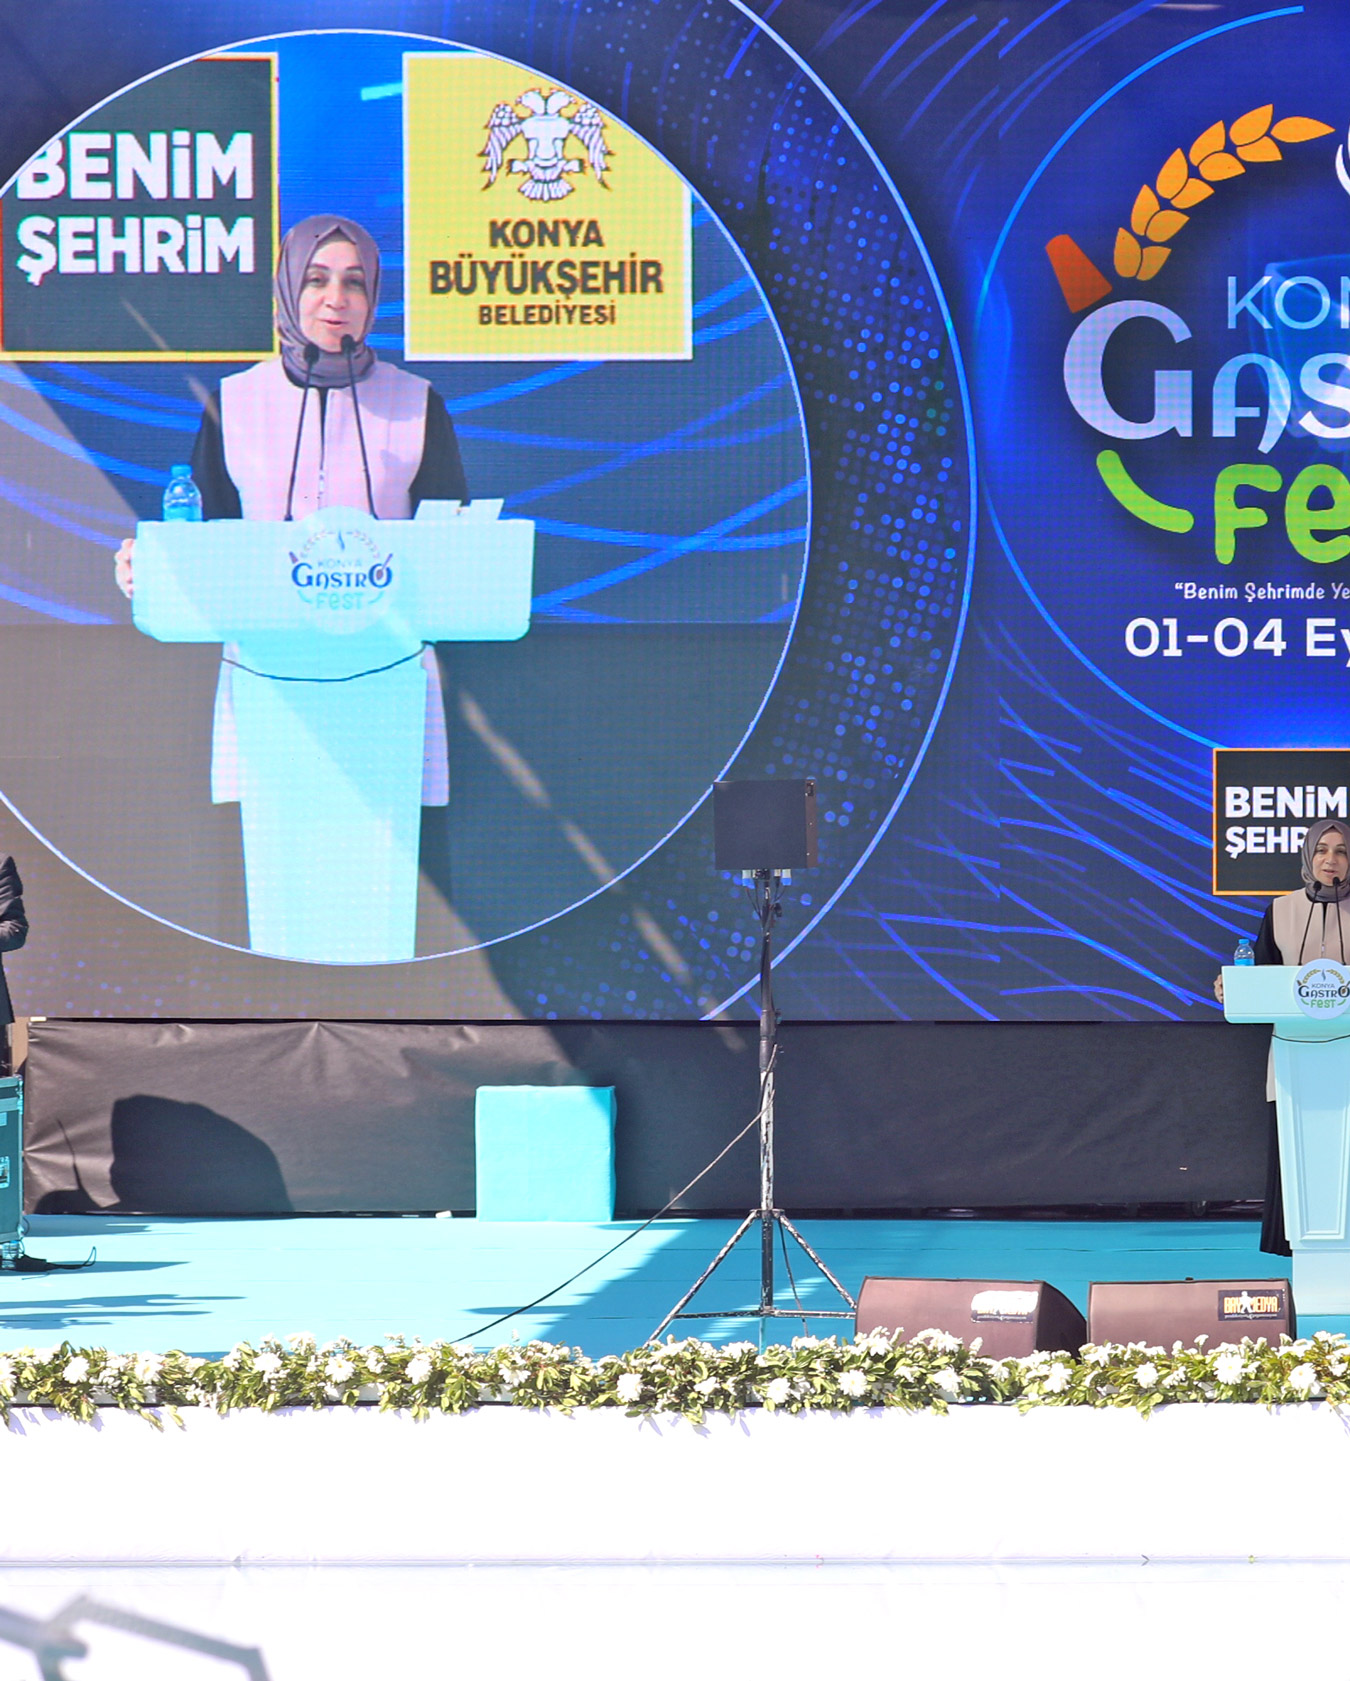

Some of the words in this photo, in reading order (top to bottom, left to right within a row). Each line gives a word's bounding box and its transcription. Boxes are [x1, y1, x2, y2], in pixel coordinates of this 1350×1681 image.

[489, 219, 604, 250] KONYA
[429, 250, 665, 298] BÜYÜKŞEHİR
[478, 299, 616, 327] BELEDİYESİ
[1244, 582, 1325, 603] Şehrimde
[1125, 618, 1287, 657] 01-04
[1225, 826, 1308, 859] ŞEHR
